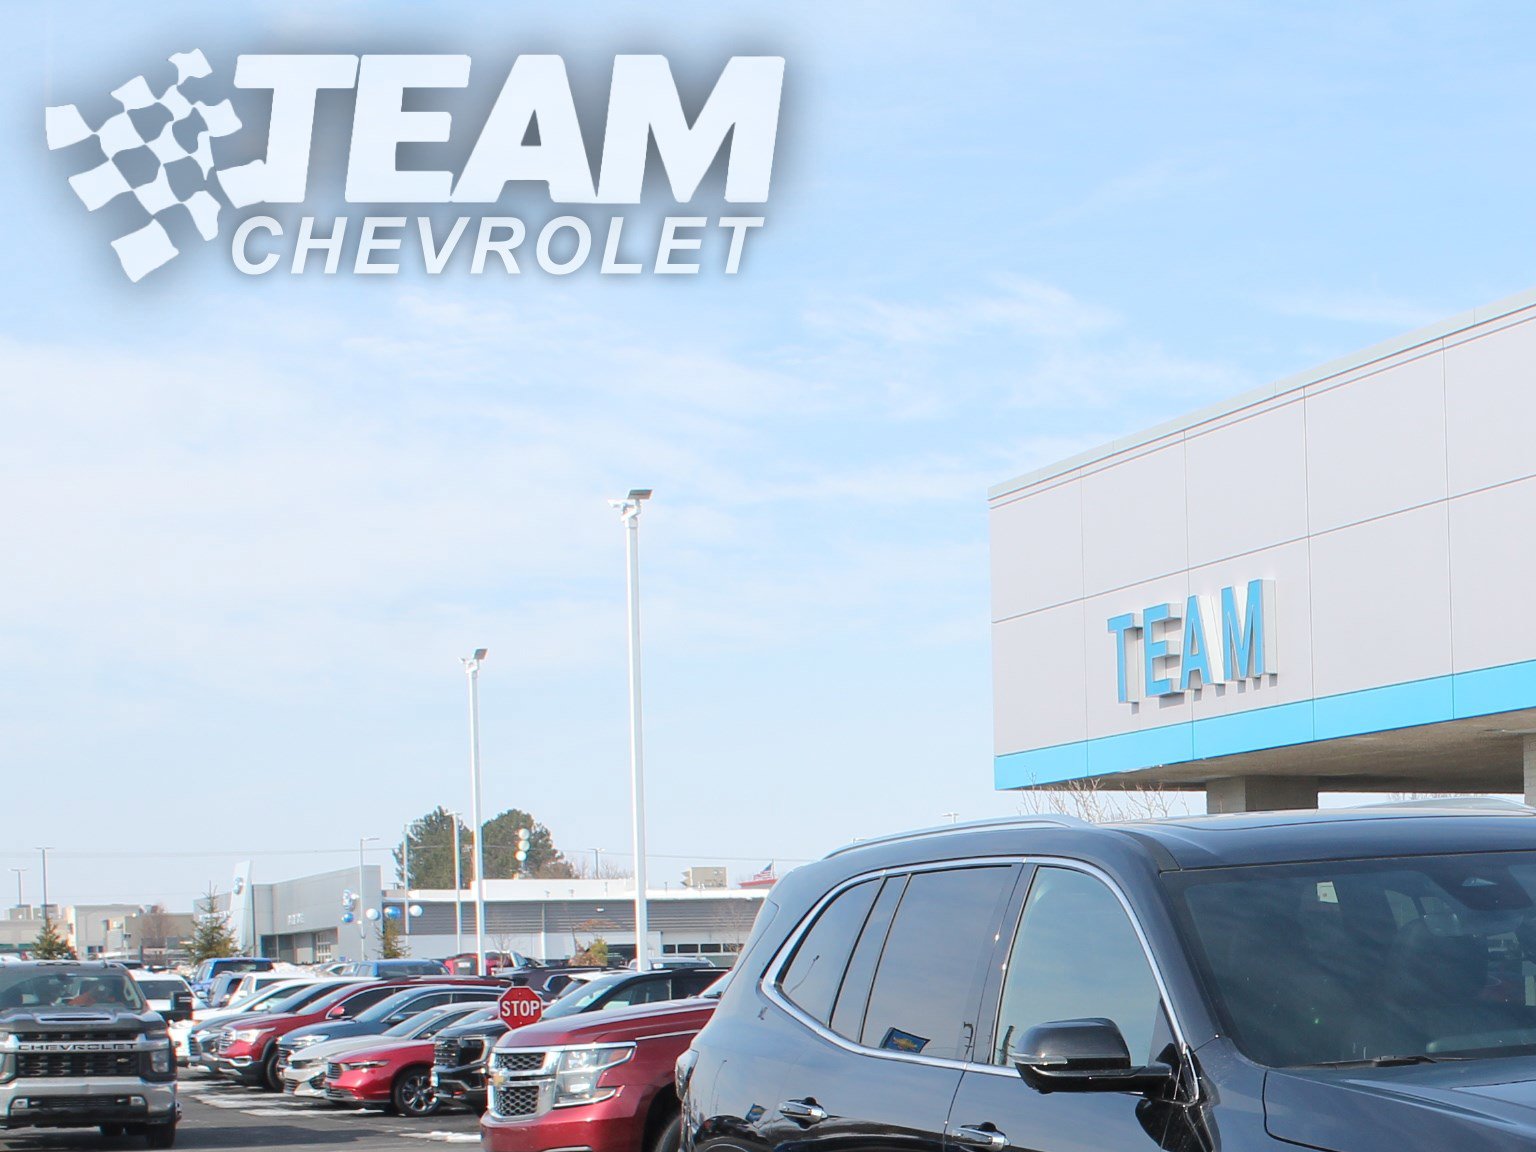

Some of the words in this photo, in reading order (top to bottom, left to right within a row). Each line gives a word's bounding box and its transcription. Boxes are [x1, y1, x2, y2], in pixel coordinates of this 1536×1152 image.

[1107, 578, 1272, 704] TEAM
[501, 1000, 540, 1017] STOP
[18, 1042, 138, 1051] CHEVROLET
